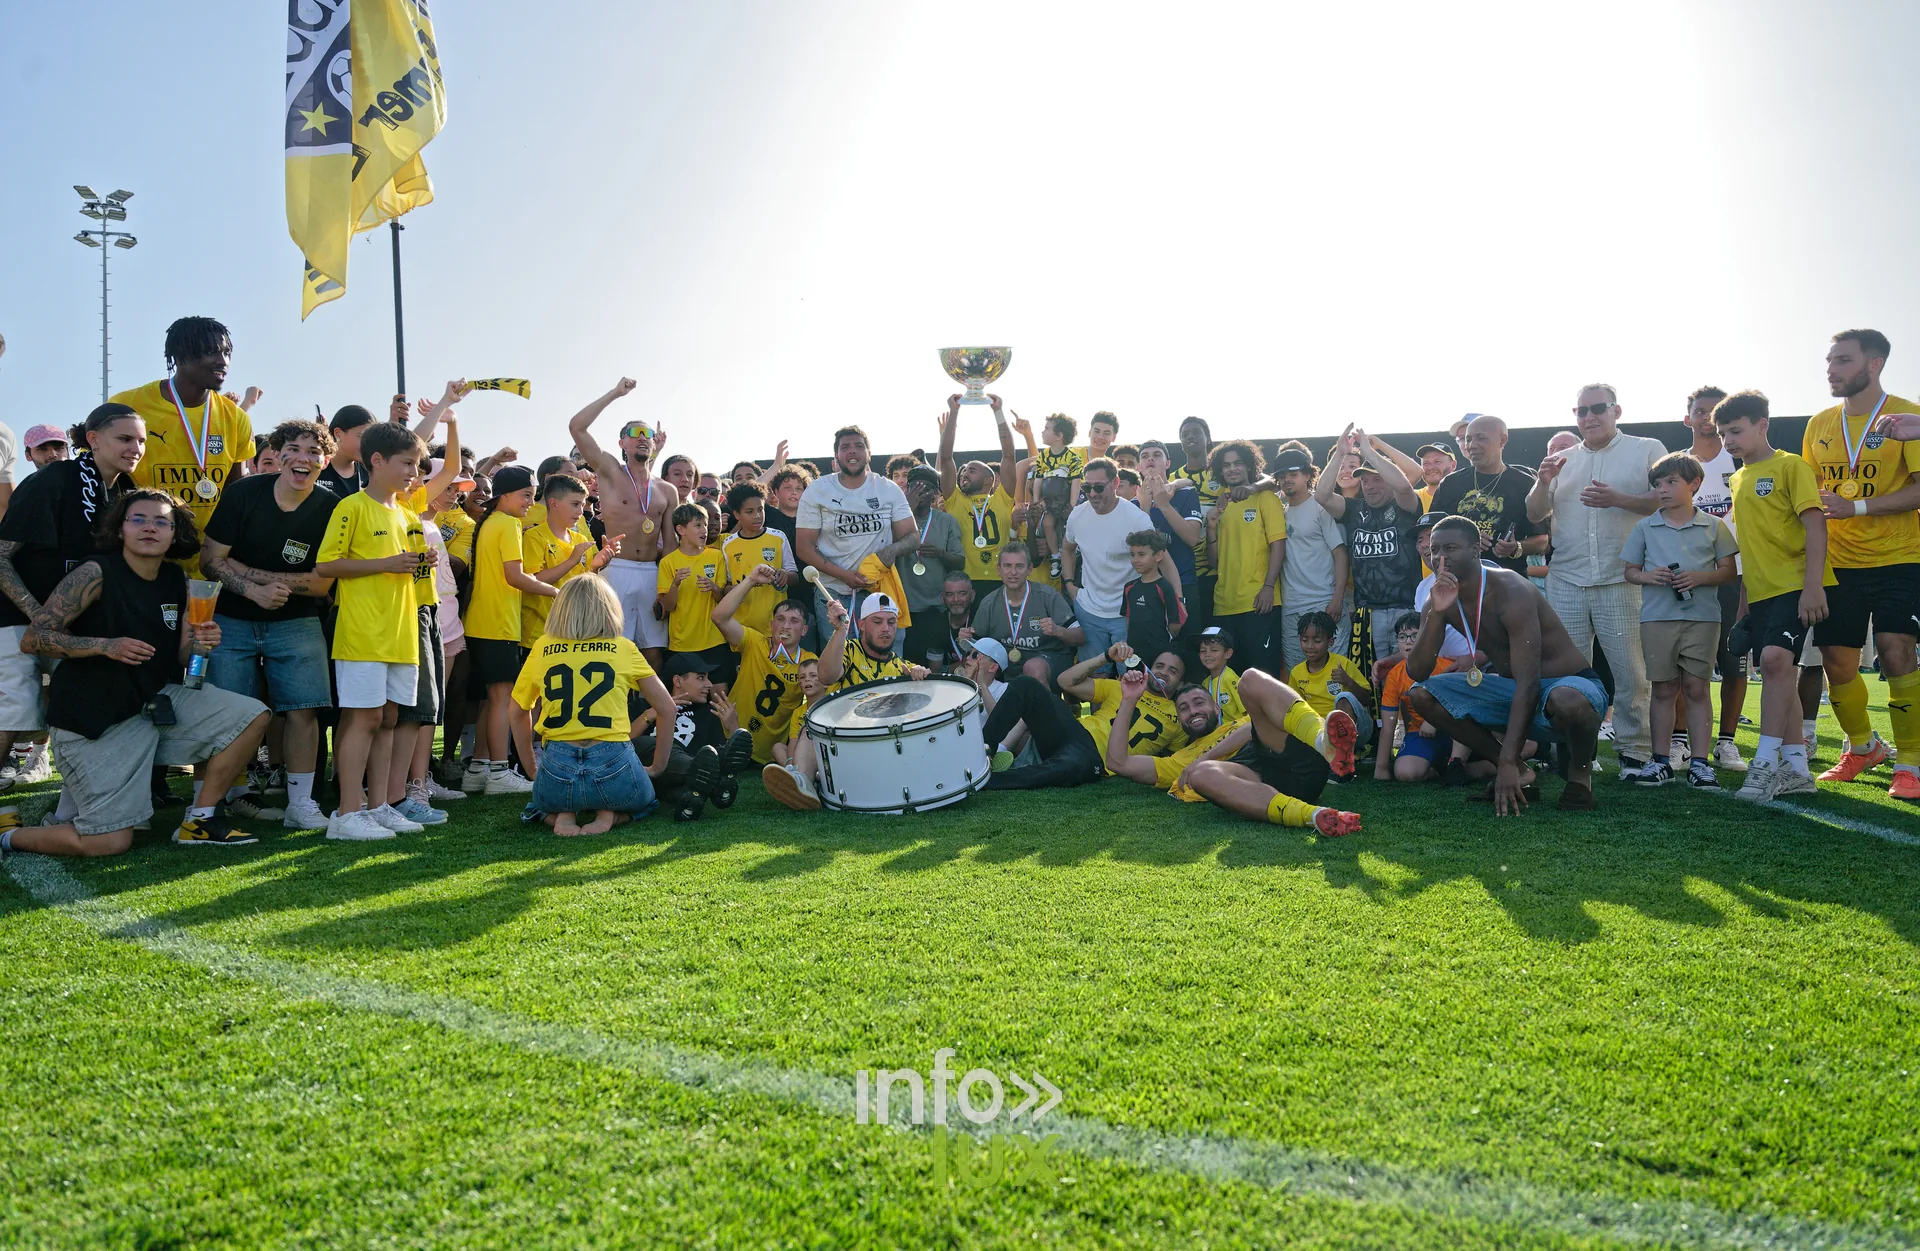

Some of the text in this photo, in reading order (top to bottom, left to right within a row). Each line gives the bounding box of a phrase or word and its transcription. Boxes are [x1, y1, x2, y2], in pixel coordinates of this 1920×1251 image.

[159, 467, 223, 484] IMMO
[1705, 504, 1728, 513] Trail
[837, 520, 882, 536] NORD
[1355, 530, 1395, 543] IMMO
[1355, 541, 1395, 556] NORD
[543, 643, 569, 657] RIOS
[543, 661, 616, 729] 92
[755, 674, 786, 718] 8
